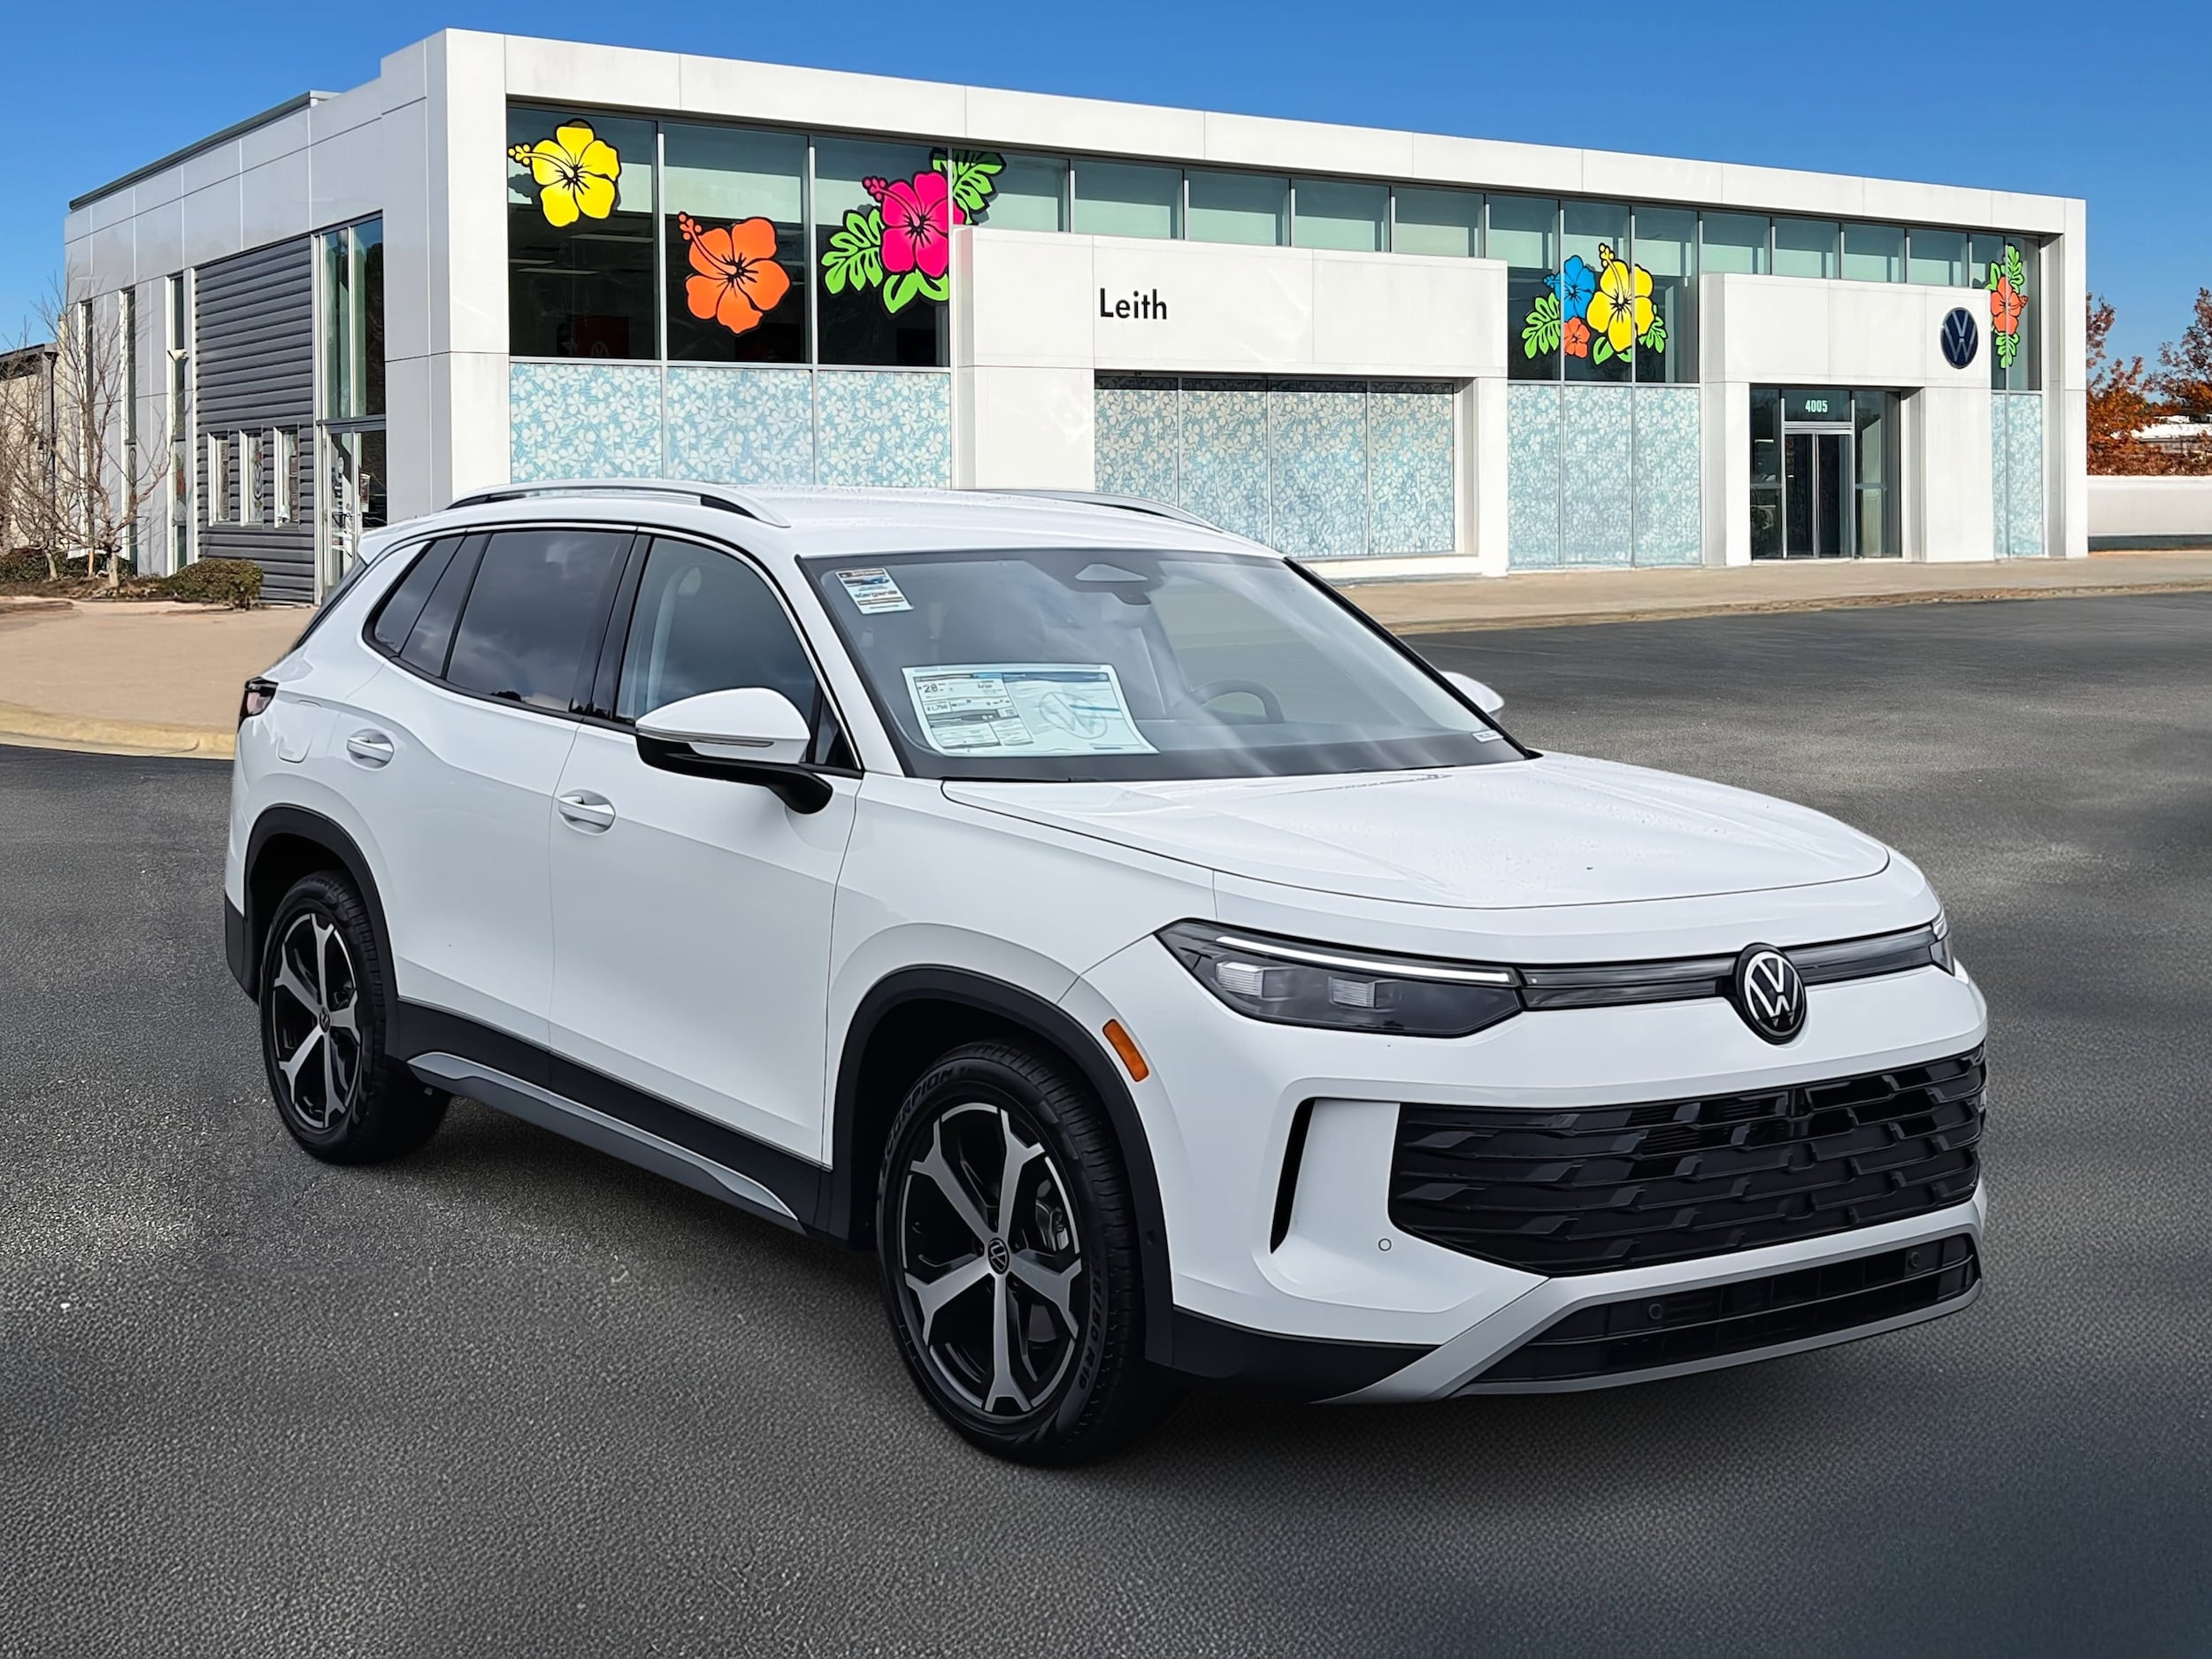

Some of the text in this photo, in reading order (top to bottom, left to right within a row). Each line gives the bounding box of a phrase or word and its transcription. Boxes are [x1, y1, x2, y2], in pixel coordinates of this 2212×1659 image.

[1100, 288, 1167, 319] Leith
[1942, 308, 1978, 365] VW
[1805, 400, 1828, 413] 4005
[1746, 953, 1803, 1033] VW
